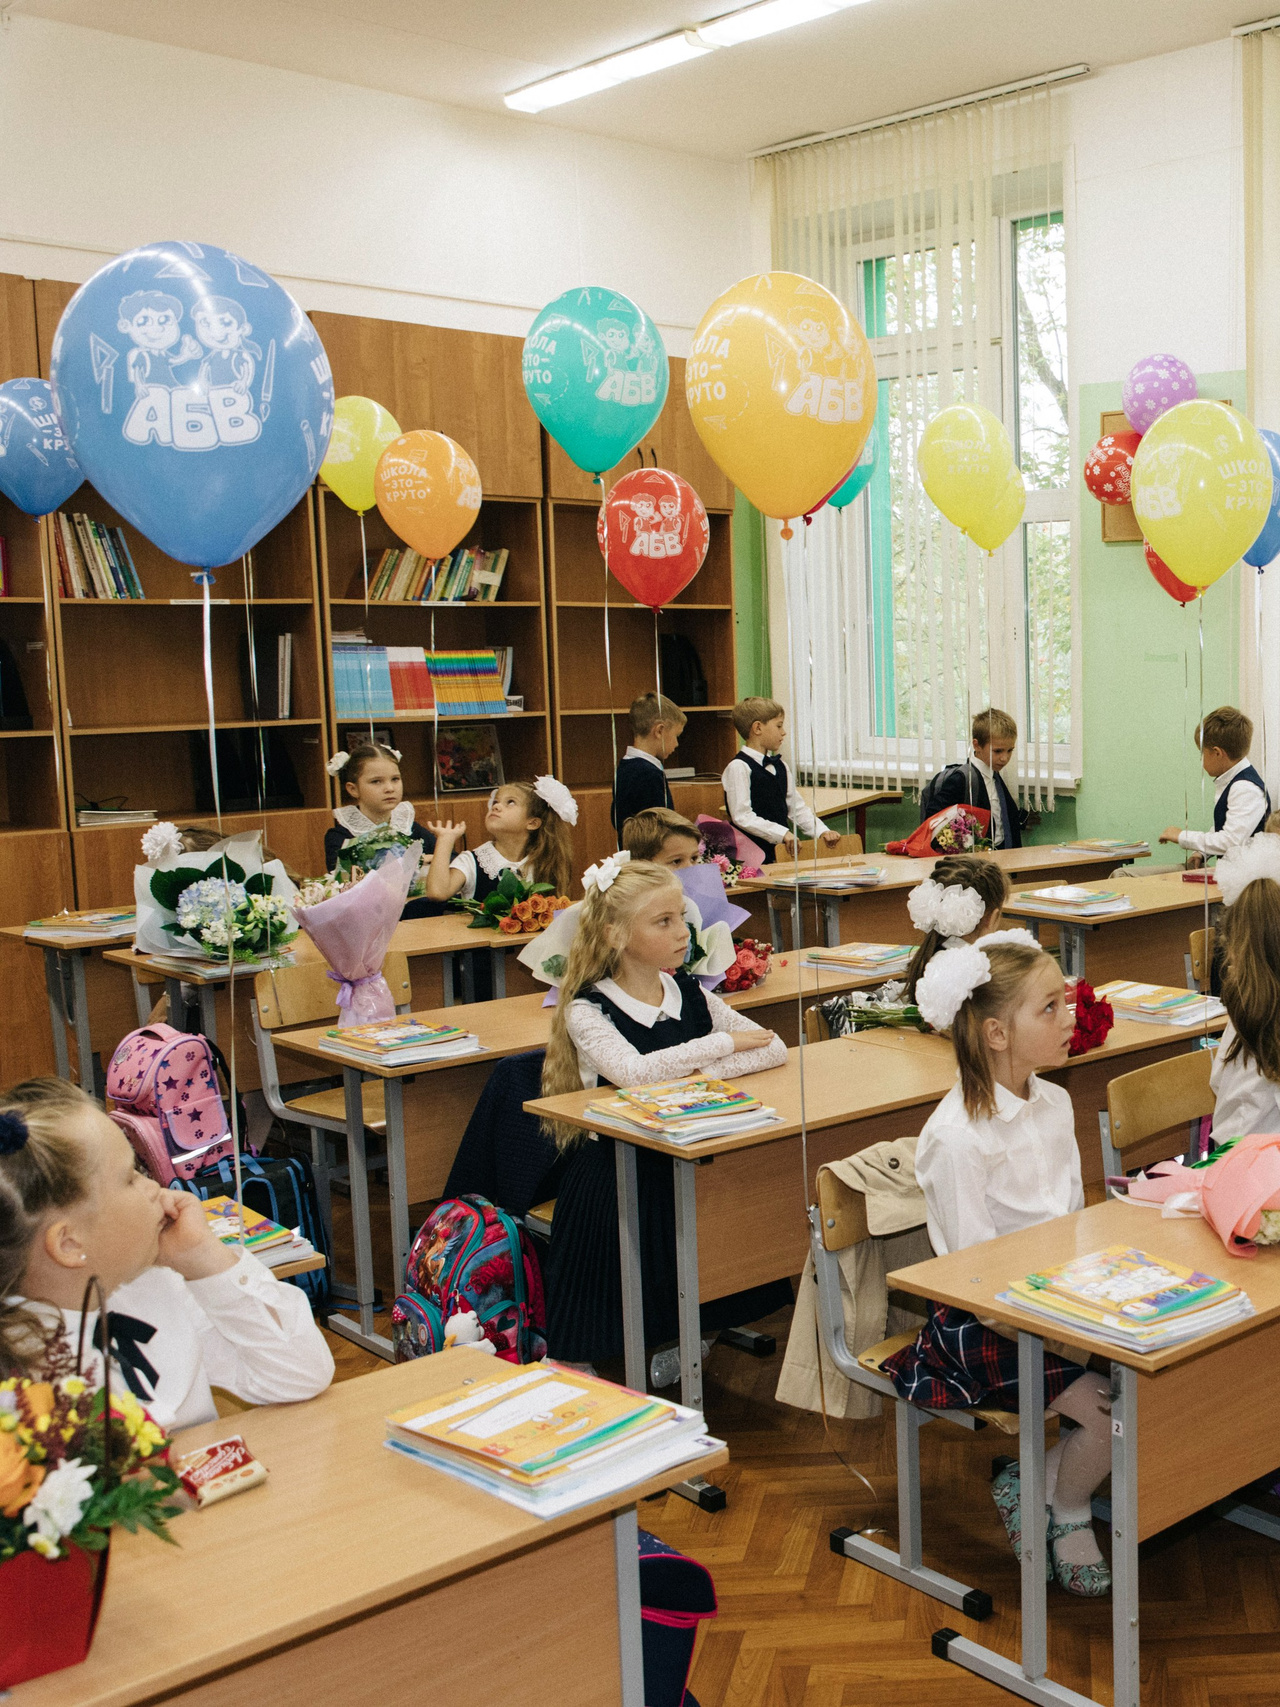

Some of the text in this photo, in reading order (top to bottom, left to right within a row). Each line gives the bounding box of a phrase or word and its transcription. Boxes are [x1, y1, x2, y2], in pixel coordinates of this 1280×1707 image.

[595, 370, 657, 406] АБВ
[784, 371, 864, 424] АБВ
[122, 384, 262, 451] АБВ
[380, 462, 429, 482] ШКОЛА
[385, 489, 427, 503] КРУТО
[456, 485, 482, 510] АБ
[629, 532, 683, 560] АБВ
[1115, 1423, 1121, 1434] 2
